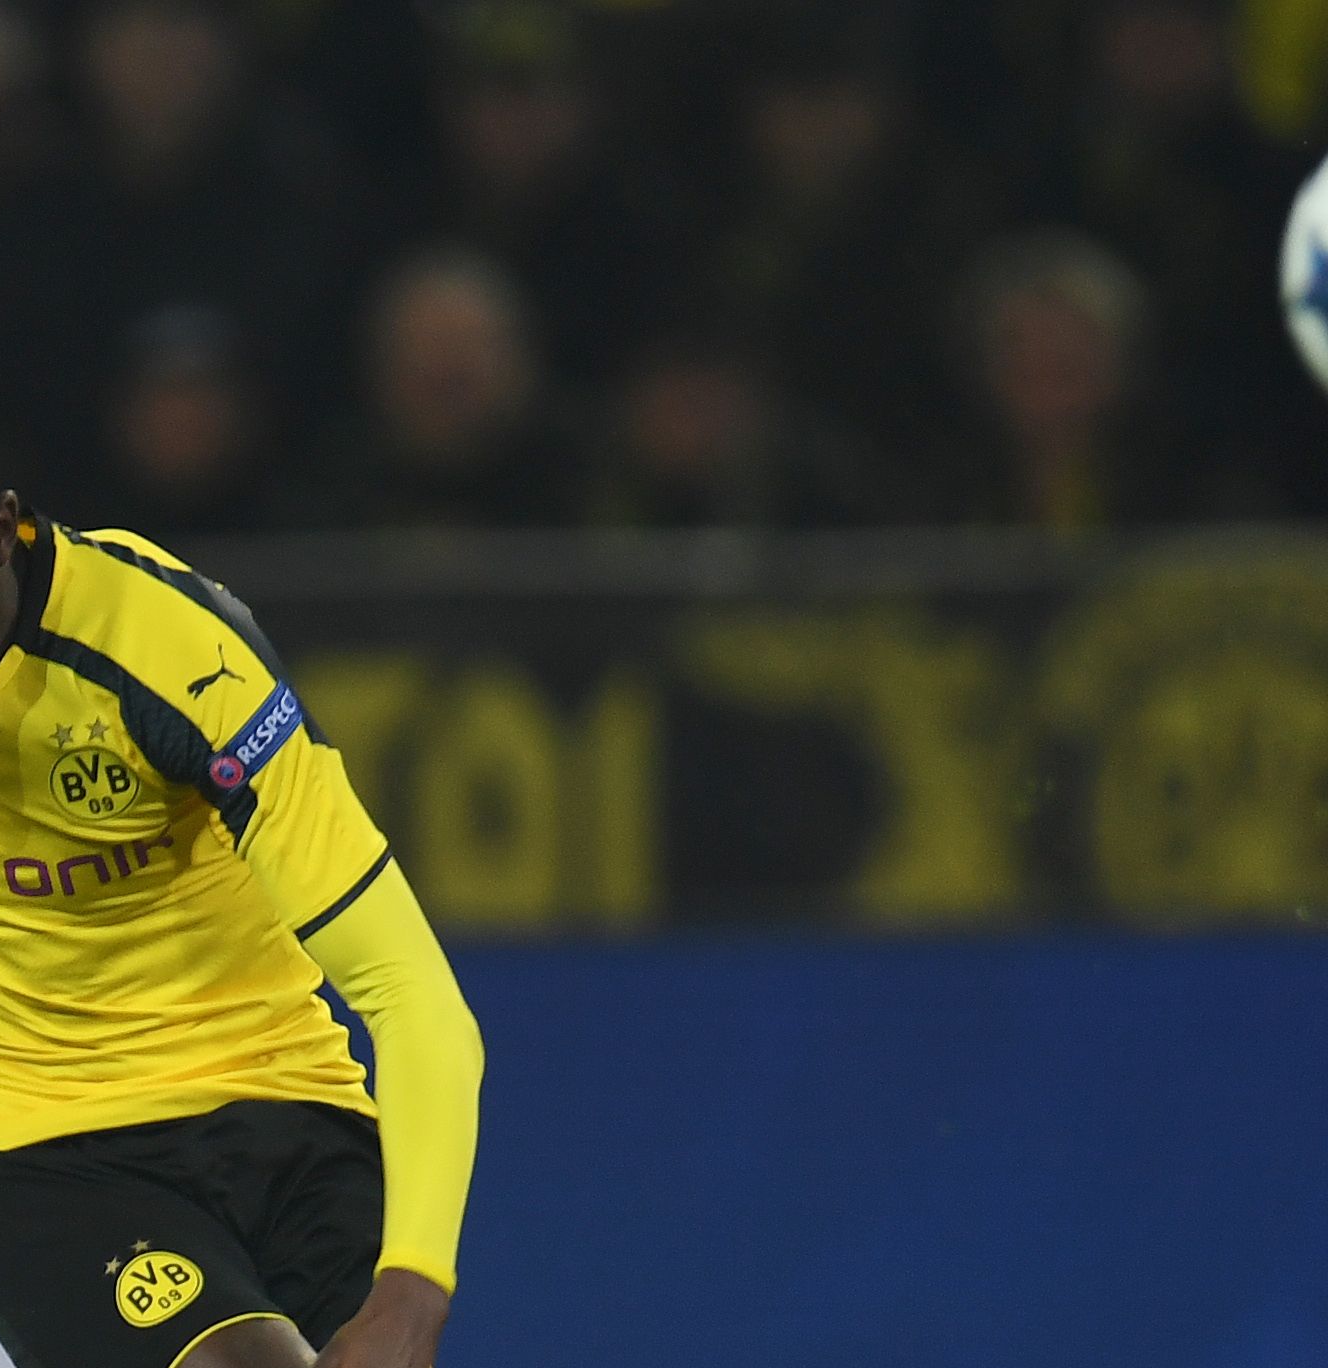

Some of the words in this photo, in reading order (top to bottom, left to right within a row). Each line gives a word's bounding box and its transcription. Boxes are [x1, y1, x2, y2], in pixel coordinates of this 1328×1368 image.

[60, 753, 131, 804] BVB
[88, 796, 115, 815] 09
[125, 1259, 191, 1316] BVB
[157, 1288, 183, 1310] 09
